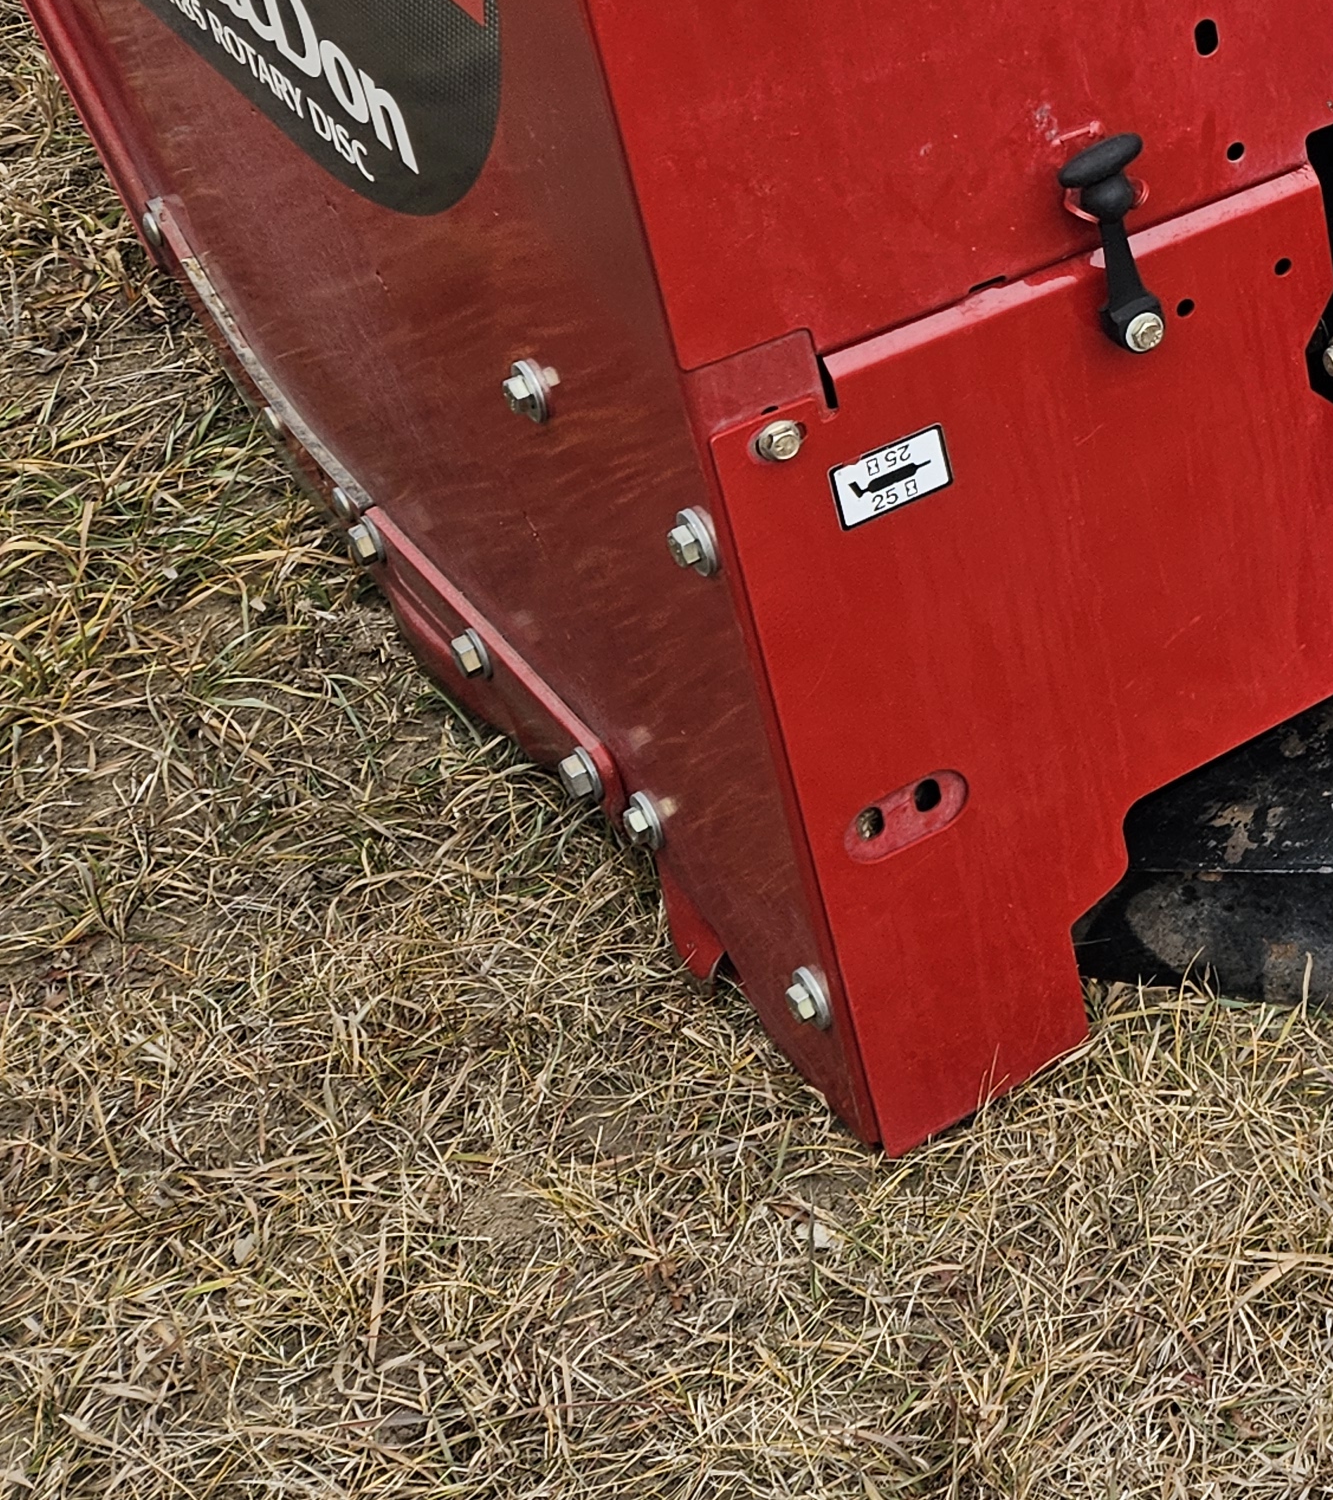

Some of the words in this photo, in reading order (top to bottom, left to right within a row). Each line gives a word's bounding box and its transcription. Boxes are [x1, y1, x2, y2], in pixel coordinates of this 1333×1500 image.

[205, 9, 304, 119] ROTARY
[306, 97, 376, 182] DISC
[884, 444, 911, 468] 25
[871, 487, 899, 512] 25
